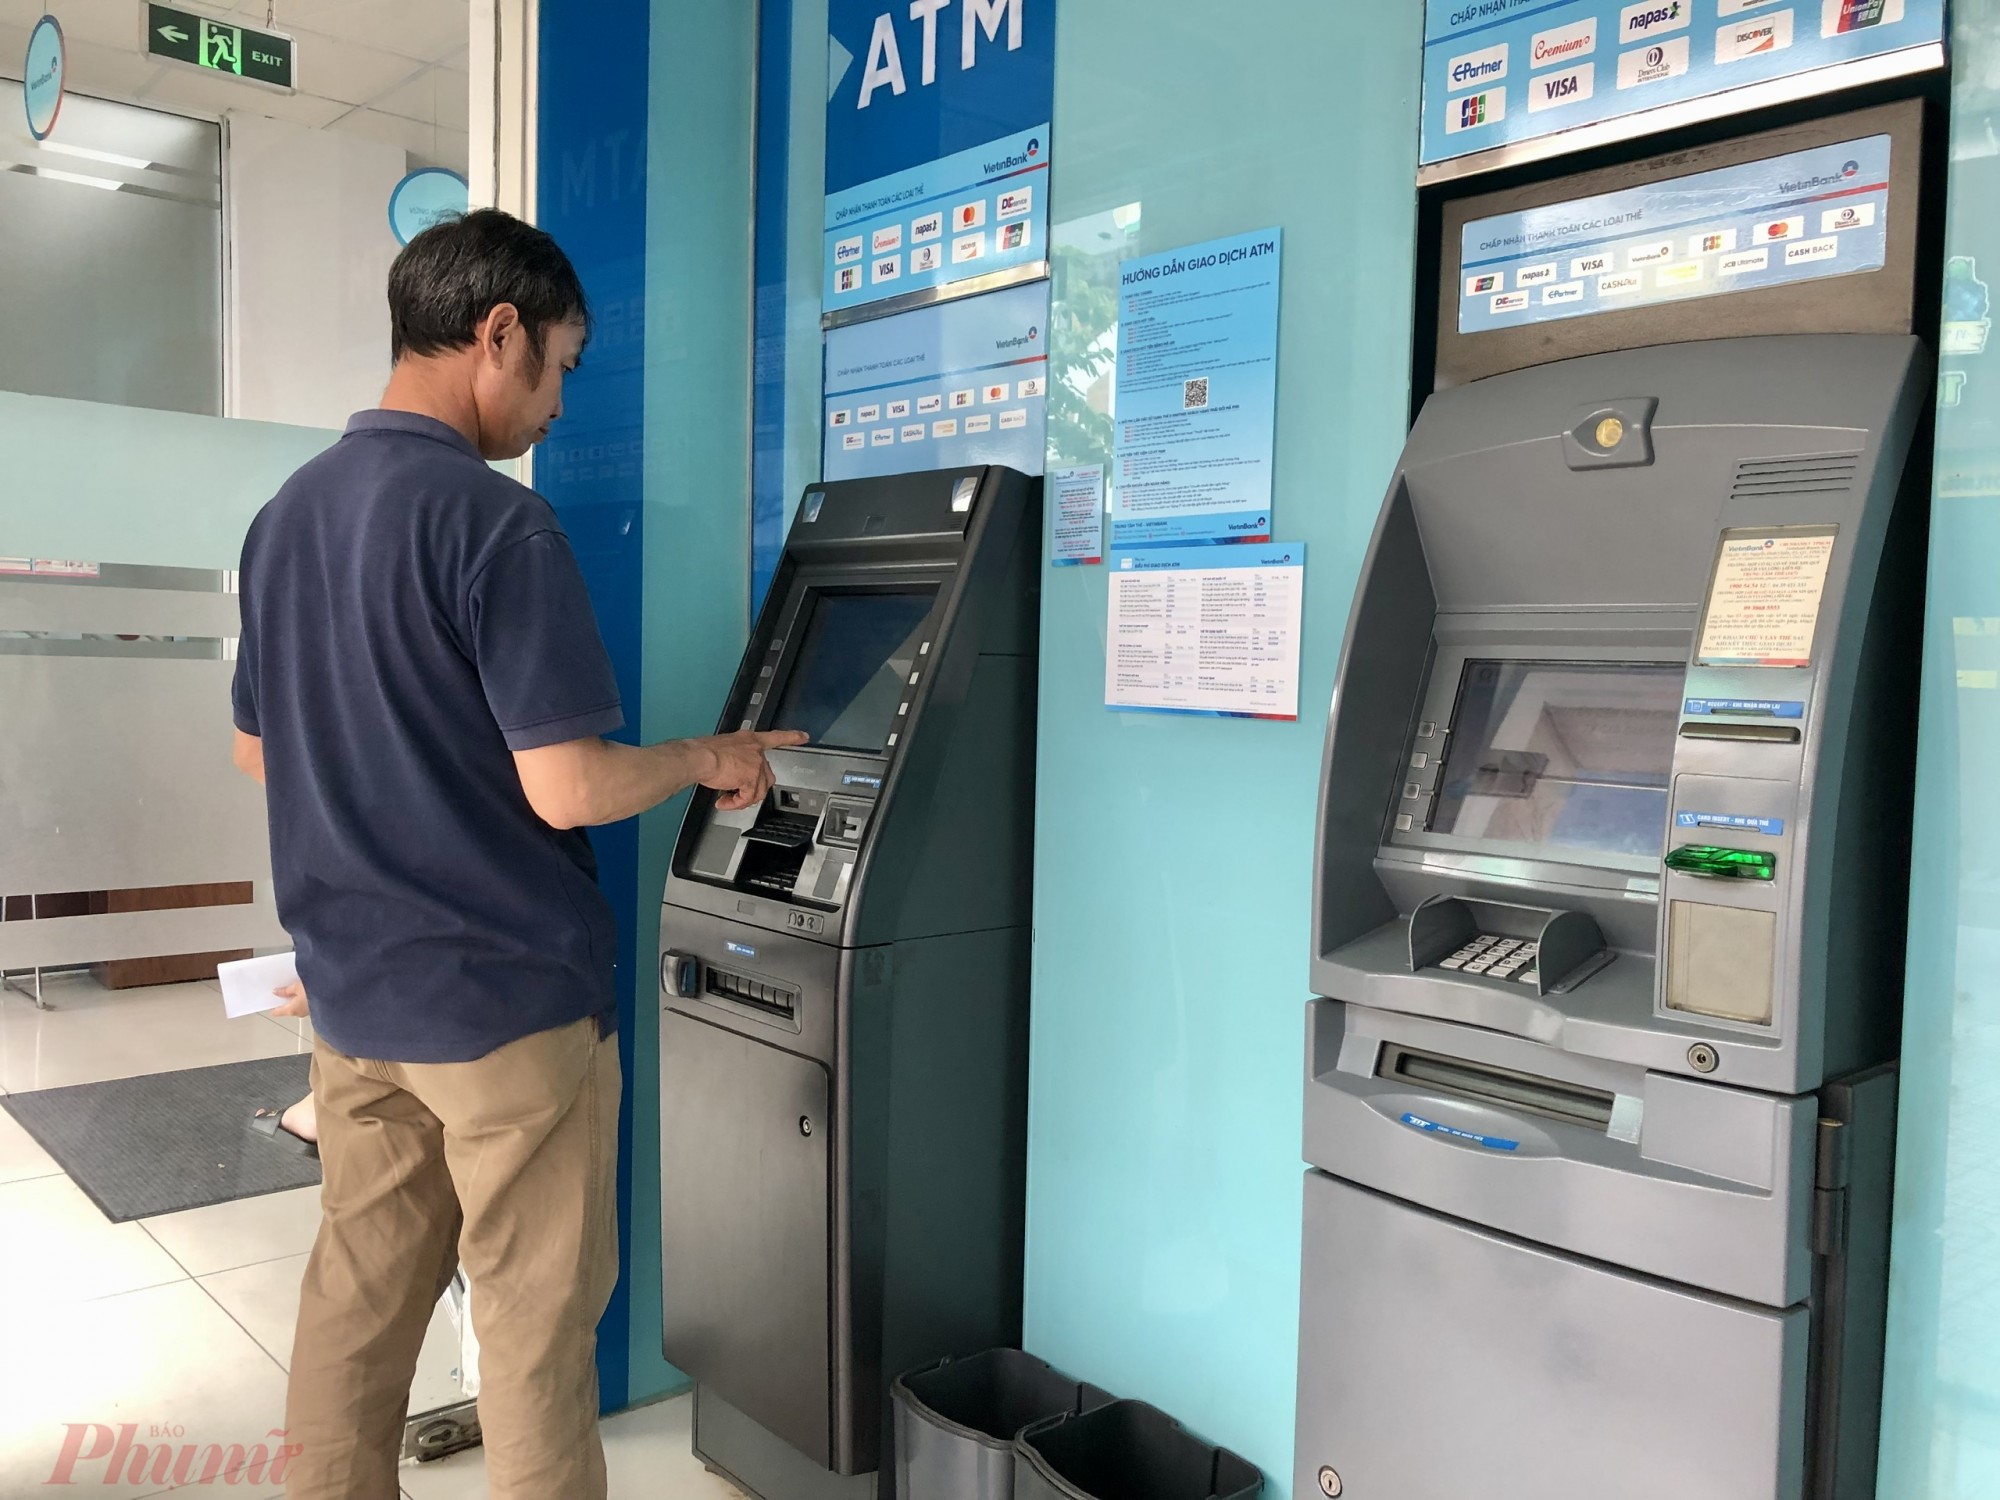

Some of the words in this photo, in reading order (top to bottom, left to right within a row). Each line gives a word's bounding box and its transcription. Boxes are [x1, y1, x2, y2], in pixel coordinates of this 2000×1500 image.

[1450, 4, 1477, 26] CHẤP
[1478, 0, 1507, 17] NHẬN
[1629, 7, 1669, 30] napas
[1736, 27, 1774, 43] DISCOVER
[857, 0, 1023, 110] ATM
[1534, 35, 1591, 60] Cremium
[252, 50, 283, 67] EXIT
[1545, 76, 1578, 99] VISA
[983, 152, 1028, 175] VietinBank
[1779, 172, 1843, 194] VietinBank
[915, 223, 933, 236] napas
[1480, 236, 1502, 251] CHẤP
[1557, 222, 1580, 235] TOÁN
[1582, 219, 1602, 231] CÁC
[1625, 209, 1643, 222] THẺ
[1788, 248, 1810, 257] CASH
[1812, 244, 1834, 254] BACK
[879, 262, 894, 276] VISA
[1122, 266, 1161, 286] HƯỚNG
[1162, 258, 1185, 276] DẪN
[1187, 254, 1216, 273] GIAO
[1219, 247, 1247, 266] DỊCH
[1249, 241, 1274, 258] ATM
[1581, 259, 1604, 271] VISA
[1522, 270, 1544, 281] napas
[892, 405, 905, 414] VISA
[1228, 522, 1258, 531] VietinBank
